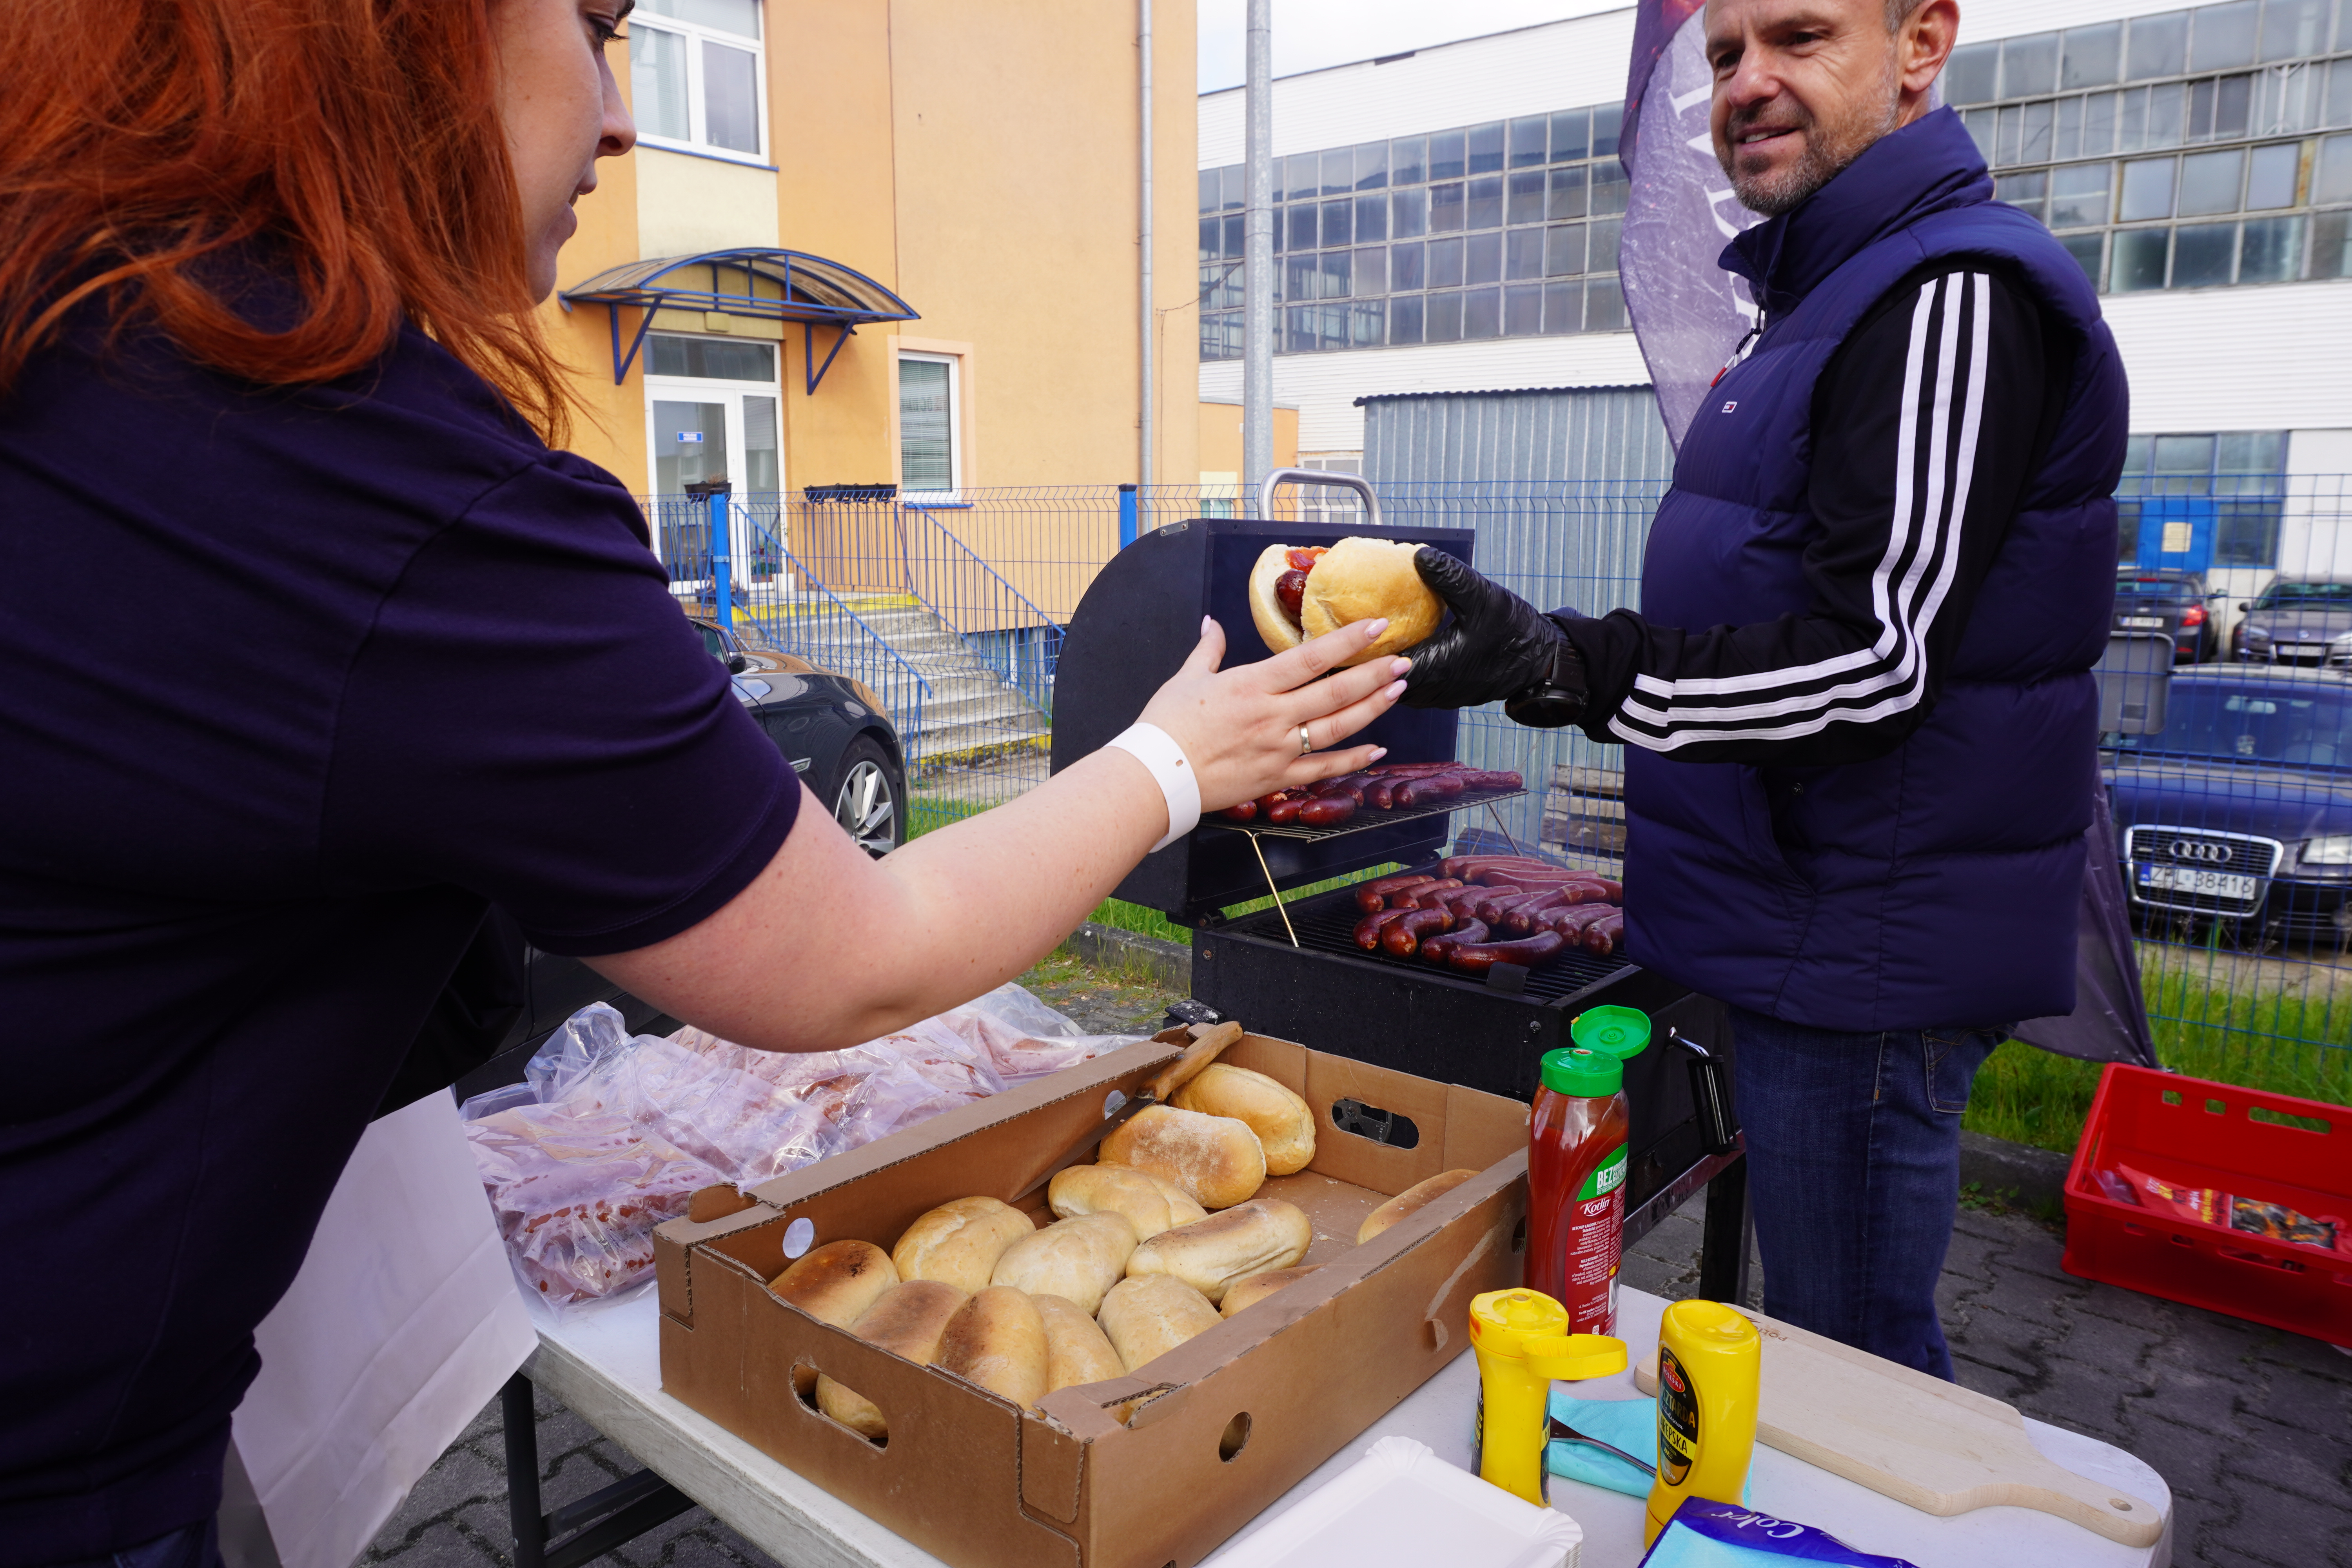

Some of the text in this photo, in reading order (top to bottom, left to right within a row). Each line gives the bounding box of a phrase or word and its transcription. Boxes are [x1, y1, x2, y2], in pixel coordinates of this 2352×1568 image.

[2152, 867, 2252, 893] ZPL 38416
[1597, 1167, 1613, 1189] BEZ
[1613, 1166, 1626, 1181] GLUTEN
[1584, 1199, 1610, 1214] Kotlin
[1663, 1366, 1681, 1389] ROLESKI
[1660, 1415, 1688, 1454] AREPSKA
[1710, 1510, 1806, 1539] Color
